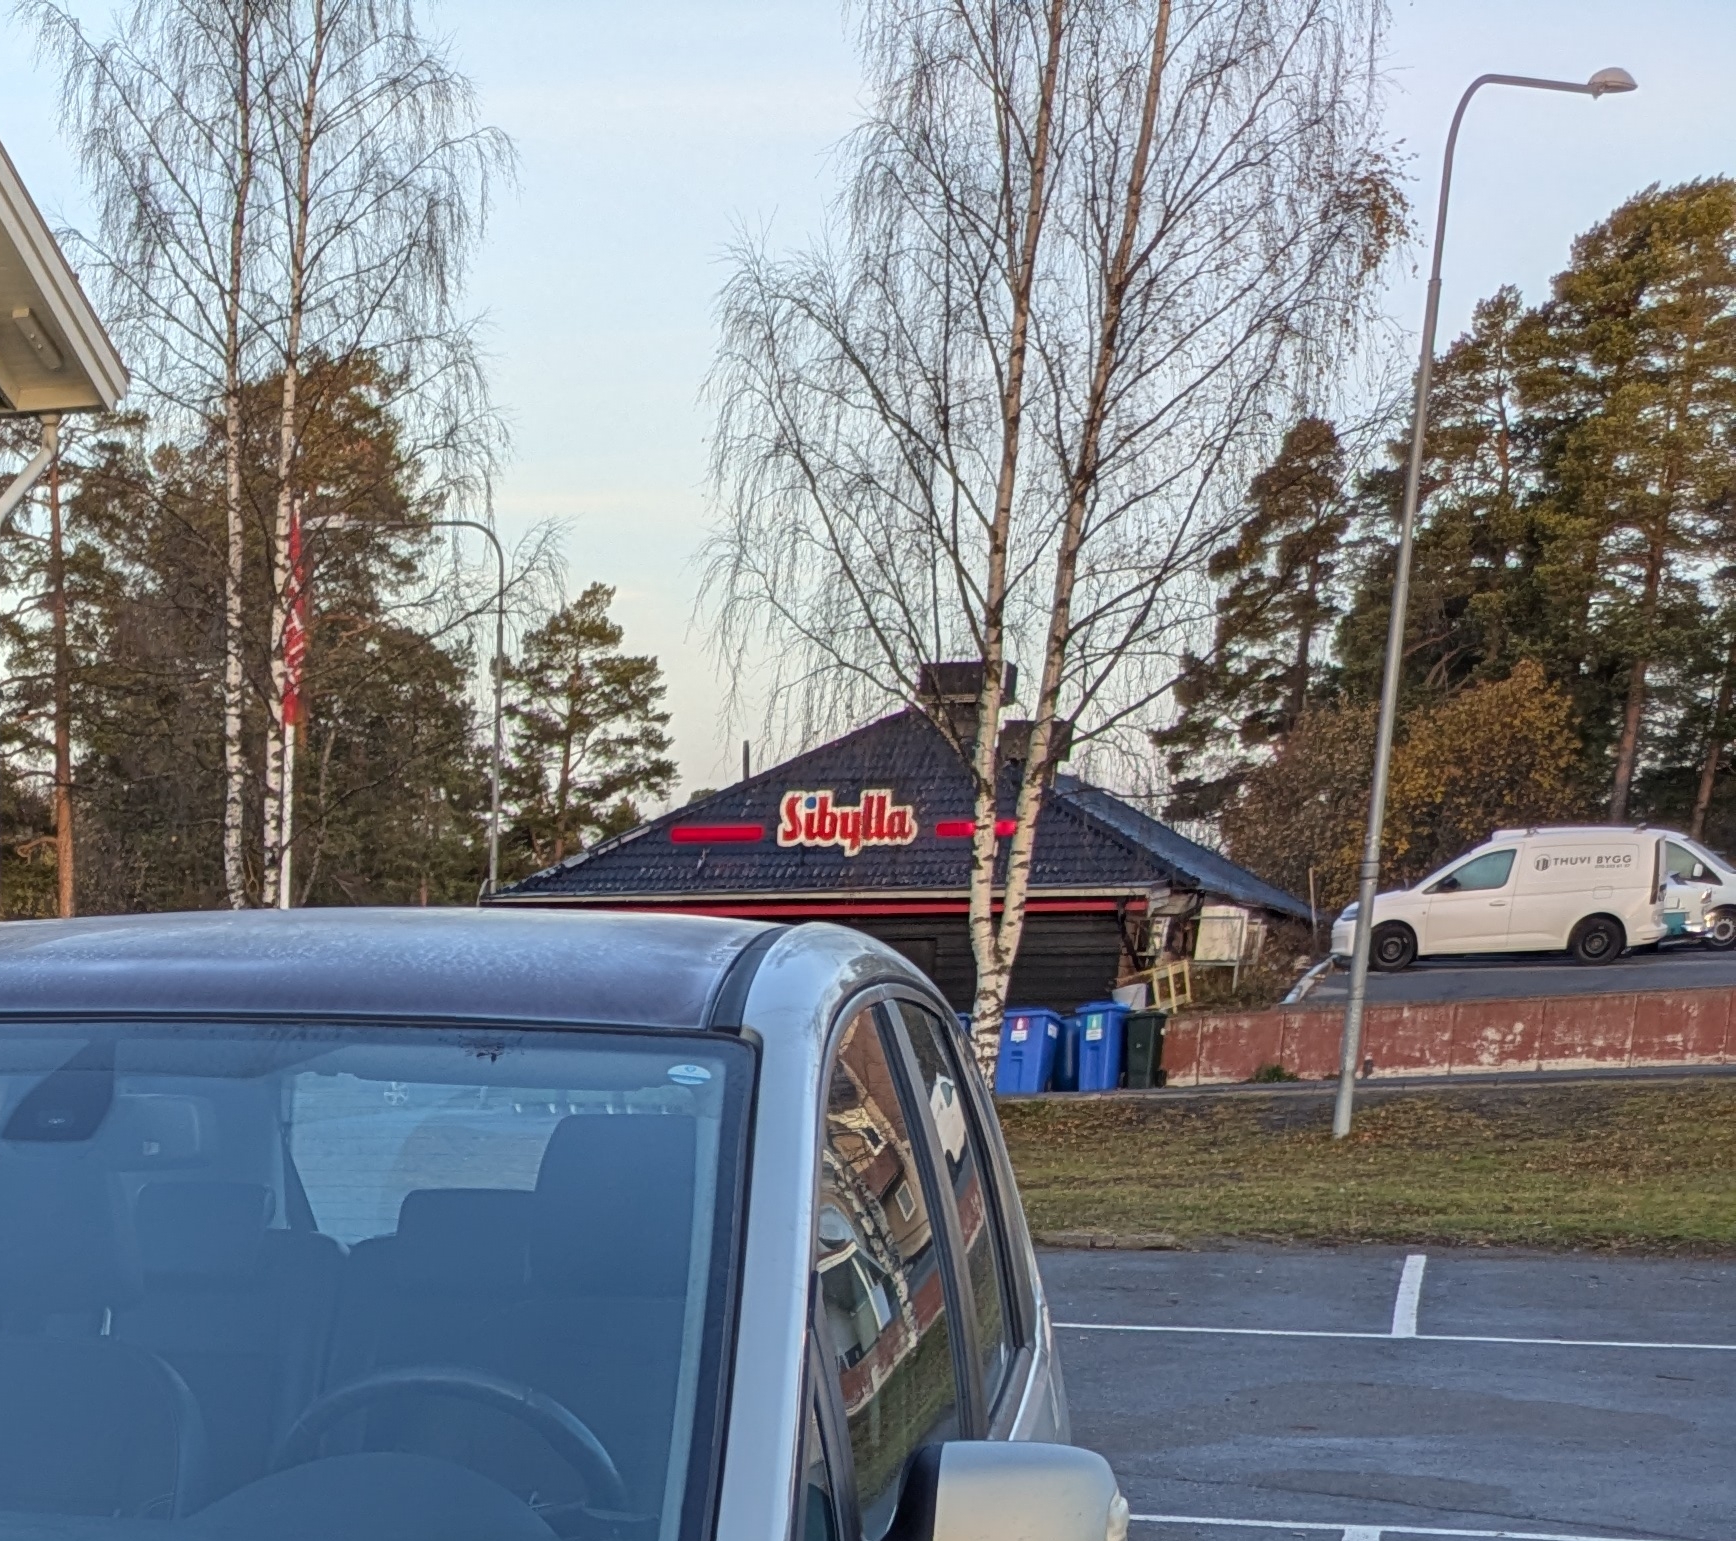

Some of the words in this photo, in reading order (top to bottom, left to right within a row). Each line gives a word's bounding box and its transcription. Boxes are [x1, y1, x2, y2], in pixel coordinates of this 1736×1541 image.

[781, 794, 914, 852] Sibylla
[1553, 856, 1591, 866] THUVI
[1596, 854, 1632, 865] BYGG
